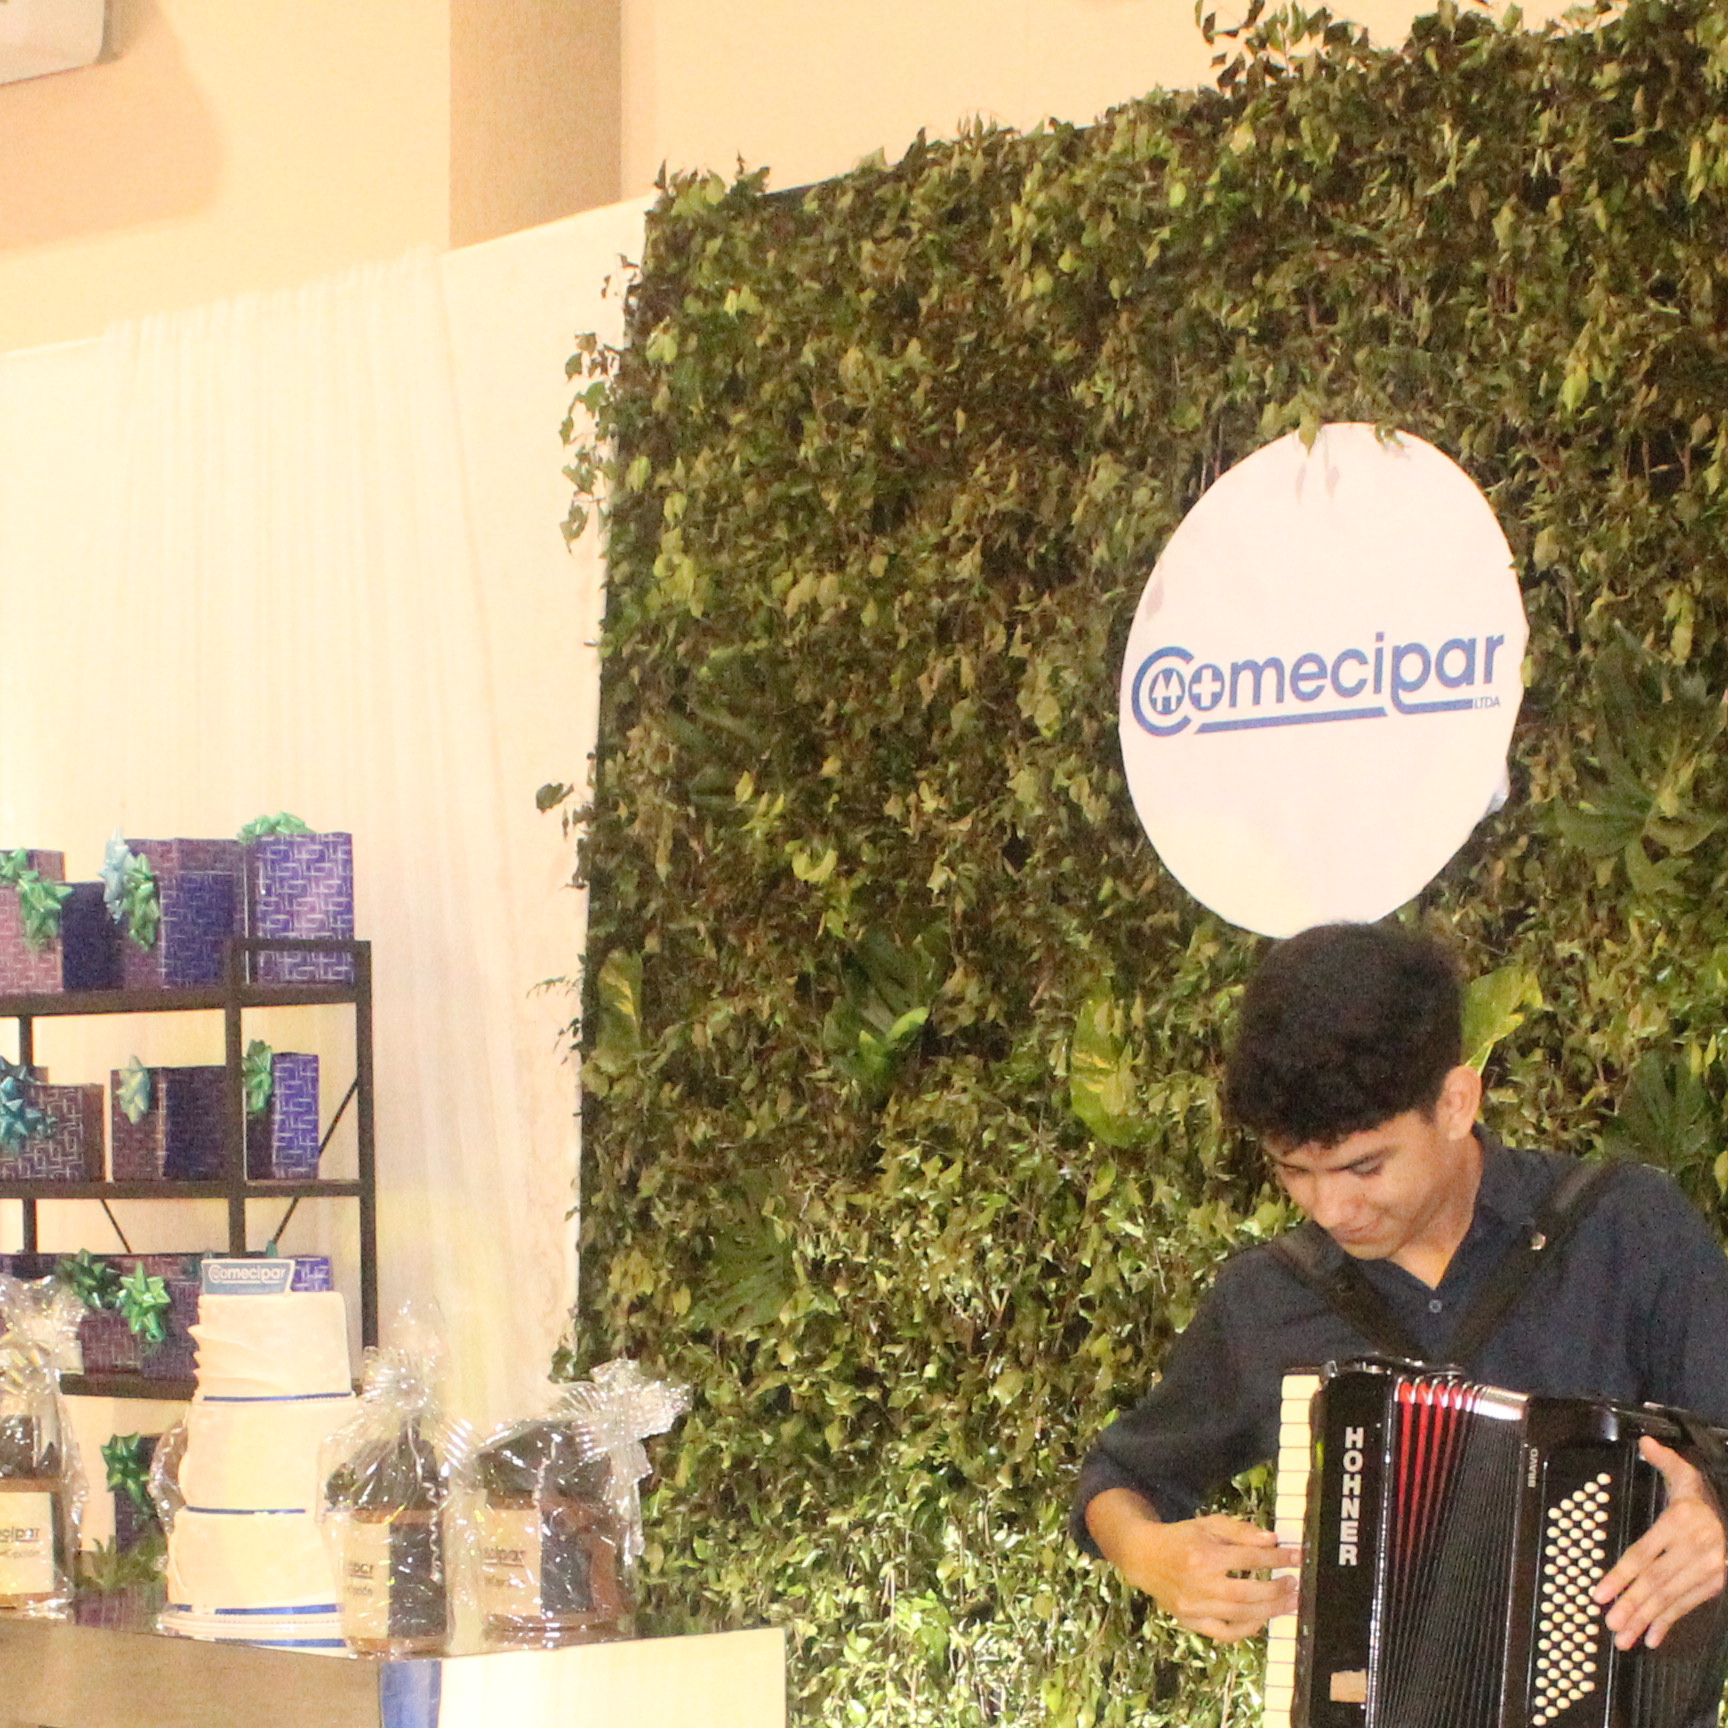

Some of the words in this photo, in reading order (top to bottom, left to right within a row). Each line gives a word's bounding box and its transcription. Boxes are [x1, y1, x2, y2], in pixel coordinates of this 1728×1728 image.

[1131, 631, 1505, 737] Comecipar
[207, 1264, 287, 1284] Comecipar
[1338, 1426, 1364, 1566] HOHNER
